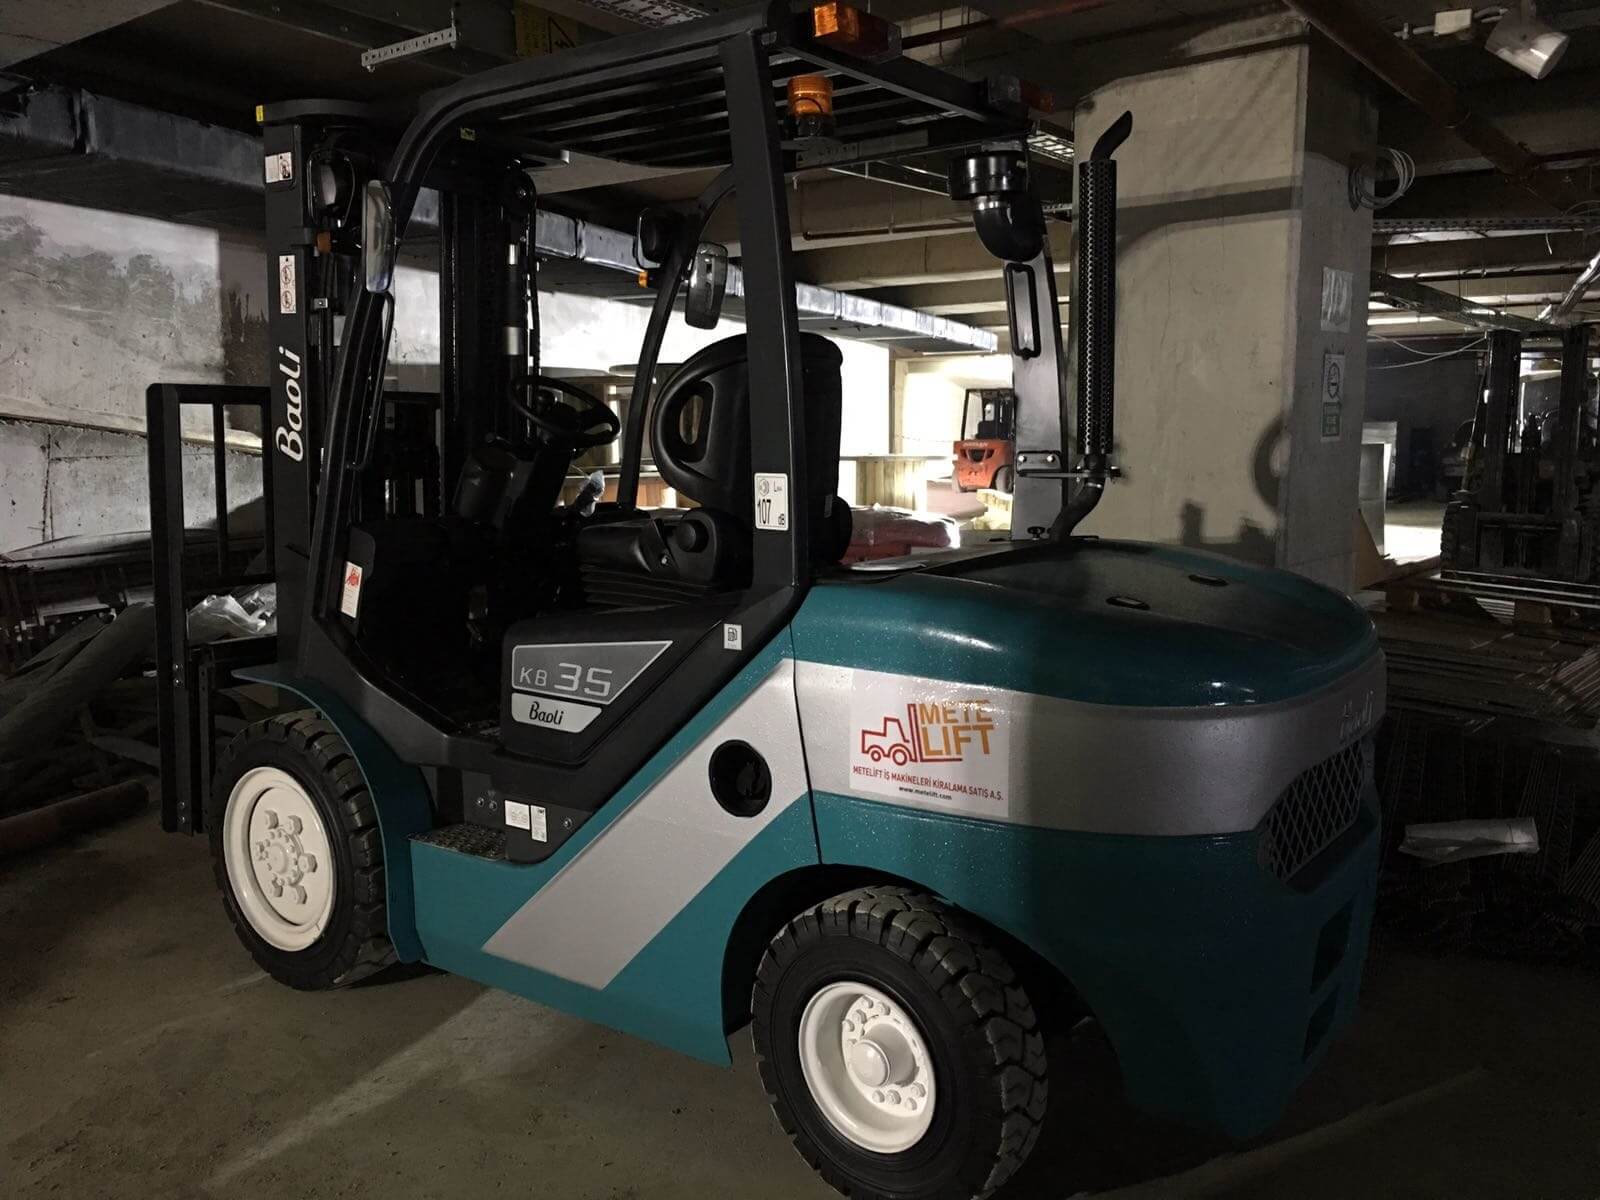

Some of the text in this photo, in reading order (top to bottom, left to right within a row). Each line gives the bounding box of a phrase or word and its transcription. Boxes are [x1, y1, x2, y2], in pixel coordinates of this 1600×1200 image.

[275, 345, 303, 462] Baoli
[757, 499, 771, 525] 107
[519, 662, 613, 697] KB 35
[528, 701, 564, 725] Baoli
[919, 699, 993, 724] METE
[922, 724, 994, 756] LIFT
[899, 786, 952, 800] www.metelift.com
[932, 778, 968, 794] KİRALAMA
